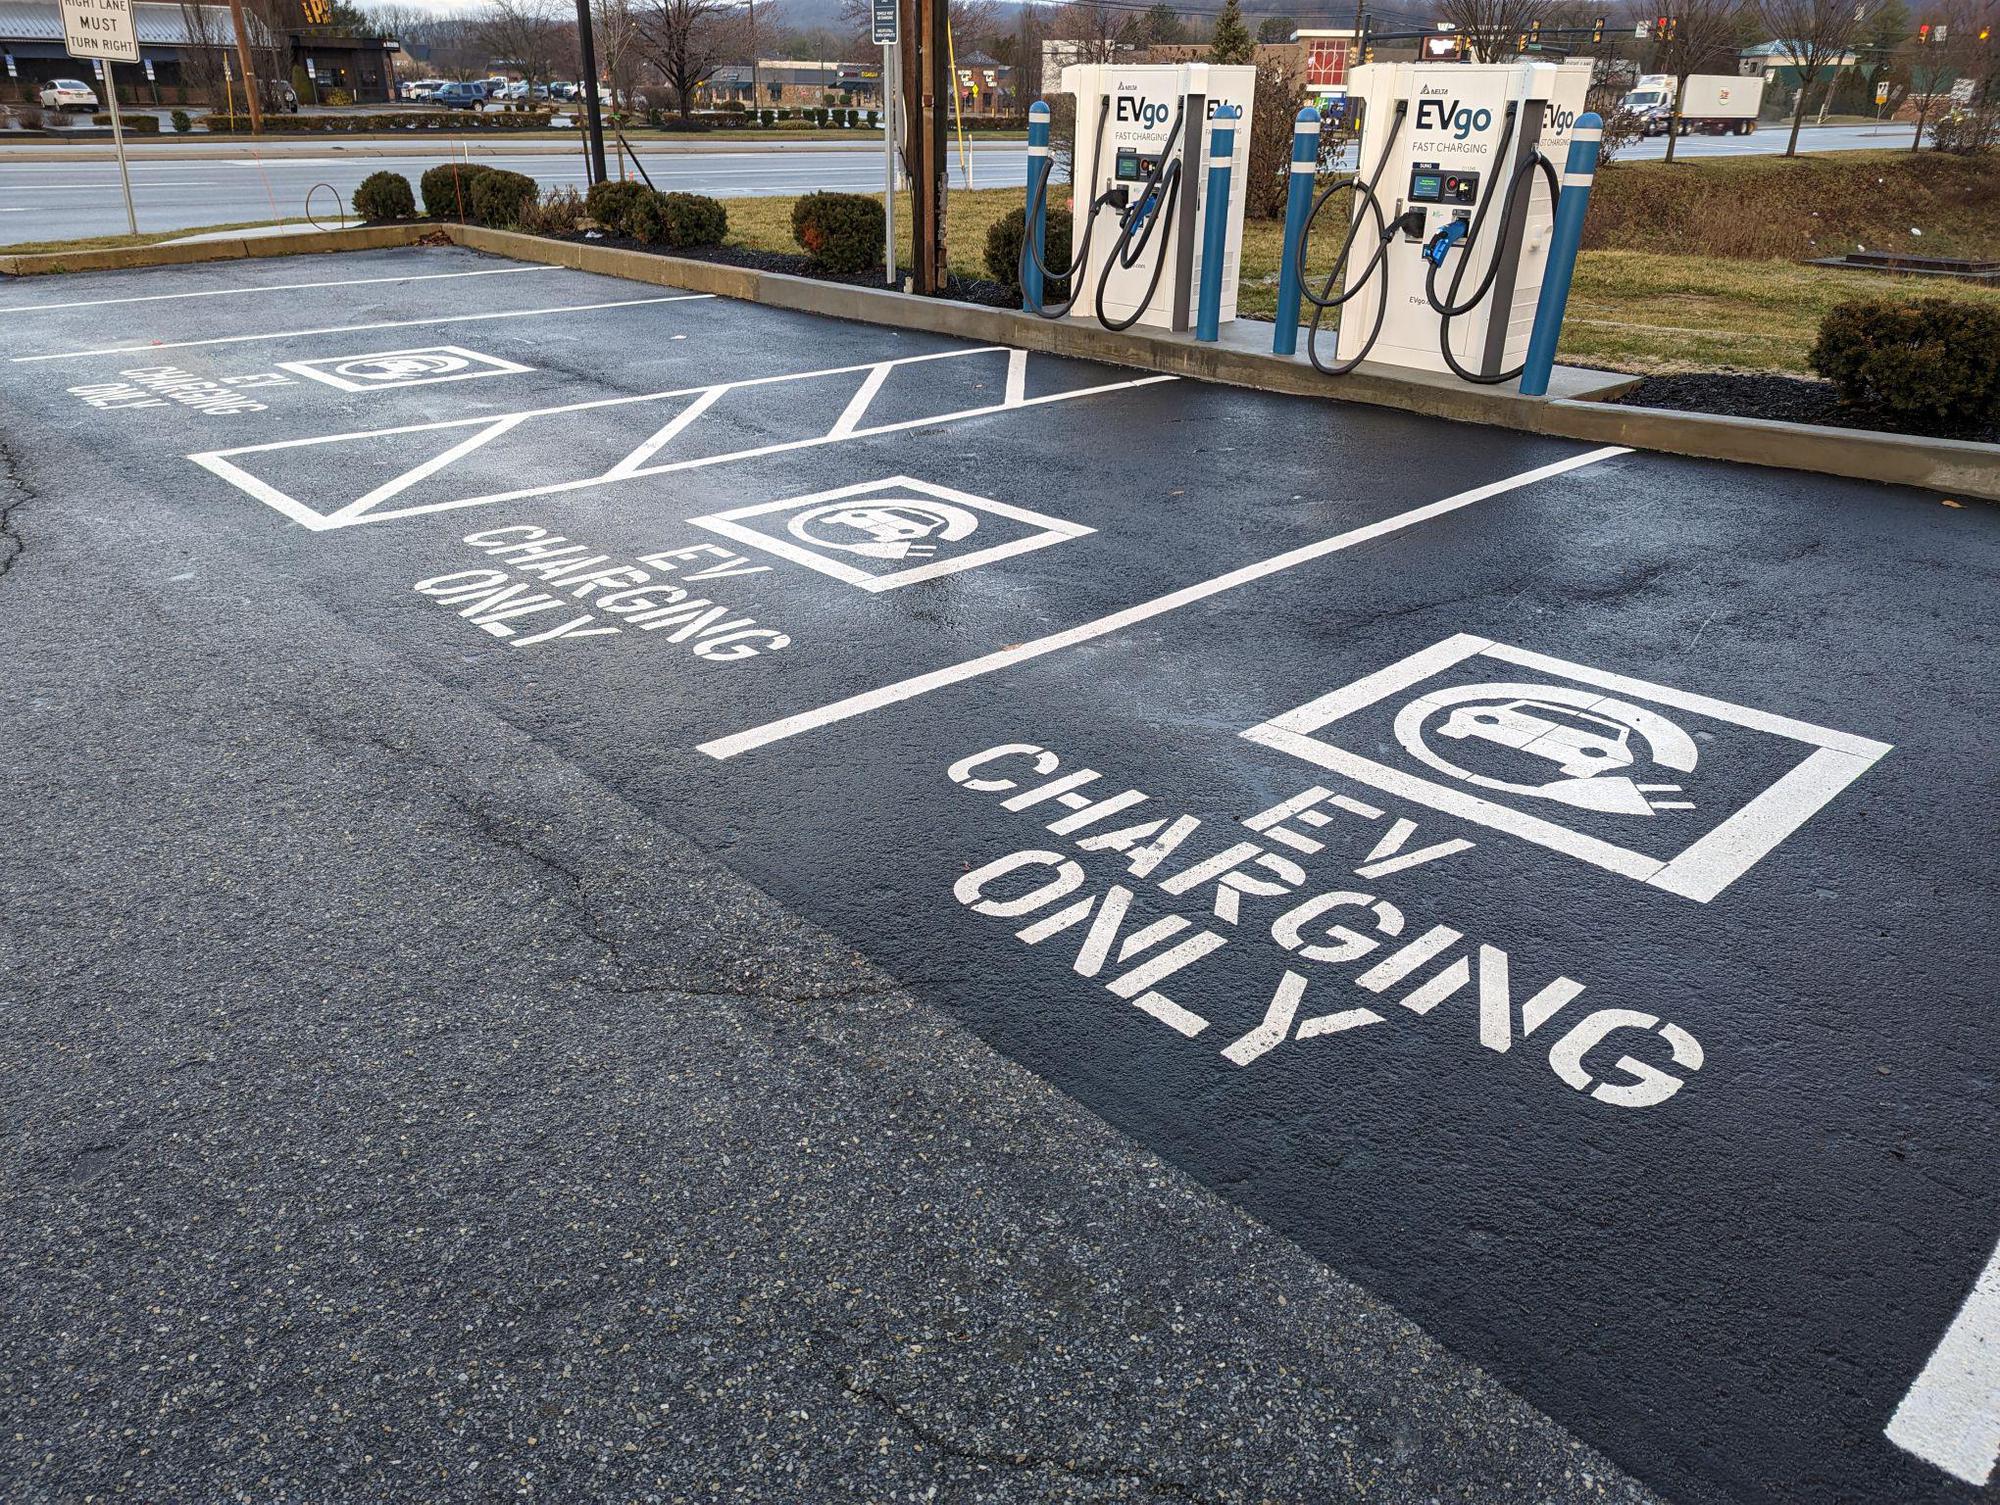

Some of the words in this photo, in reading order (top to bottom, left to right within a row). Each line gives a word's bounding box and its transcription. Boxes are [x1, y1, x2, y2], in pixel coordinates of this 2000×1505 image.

[80, 16, 117, 31] MUST
[100, 0, 127, 11] LANE
[70, 36, 98, 48] TURN
[102, 39, 133, 52] RIGHT
[1117, 96, 1169, 130] EVgo
[1207, 99, 1243, 120] Eo
[1416, 99, 1492, 140] EVgo
[1115, 131, 1132, 140] FAST
[1131, 132, 1168, 141] CHARGING
[1412, 141, 1436, 152] FAST
[1436, 142, 1488, 154] CHARGING
[637, 543, 773, 581] EV
[414, 569, 622, 647] ONLY
[463, 525, 792, 661] CHARGING
[1242, 785, 1476, 879] EV
[947, 743, 1705, 1107] CHARGING
[953, 850, 1386, 1066] ONLY
